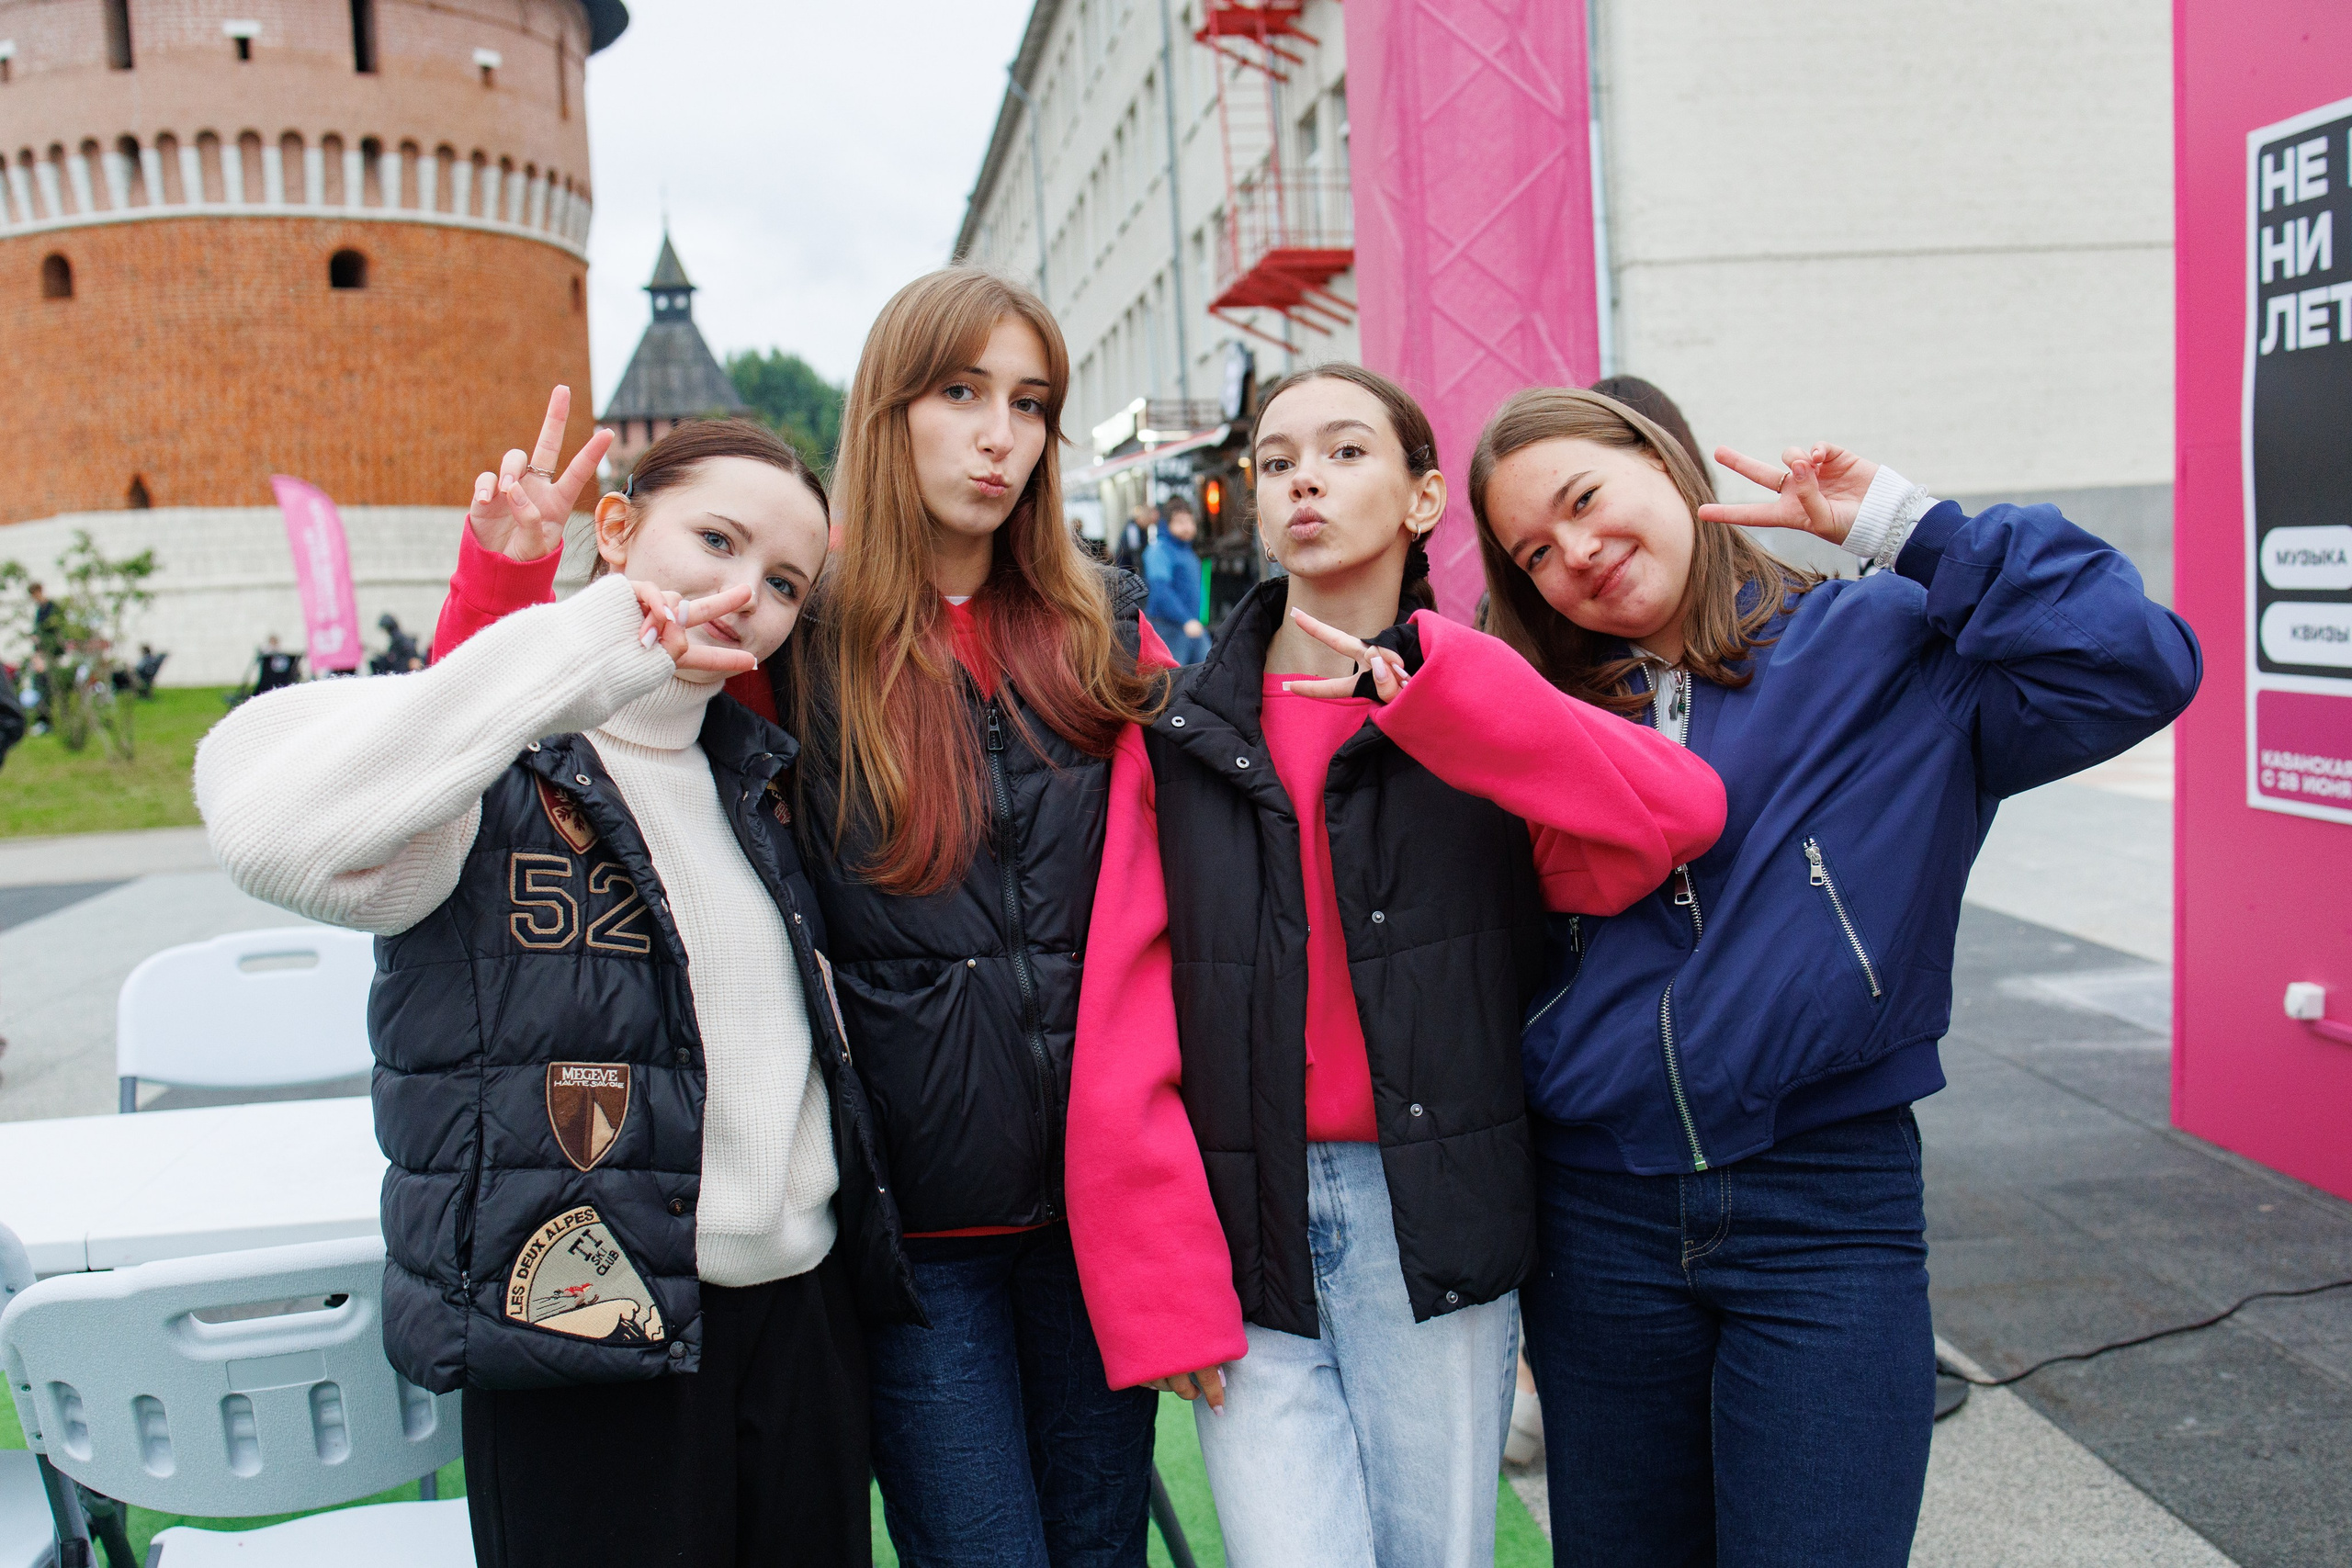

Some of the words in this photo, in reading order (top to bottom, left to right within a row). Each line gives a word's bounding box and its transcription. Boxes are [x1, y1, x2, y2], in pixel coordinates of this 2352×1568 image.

[2261, 136, 2328, 212] НЕ
[2261, 210, 2333, 284] НИ
[2277, 549, 2346, 566] МУЗЫКА
[2291, 626, 2350, 642] КВИЗЫ
[510, 852, 650, 953] 52
[545, 1208, 596, 1241] ALPES
[516, 1238, 546, 1280] DEUX
[591, 1247, 607, 1266] SKI
[596, 1249, 619, 1276] CLUB
[510, 1285, 526, 1315] LES
